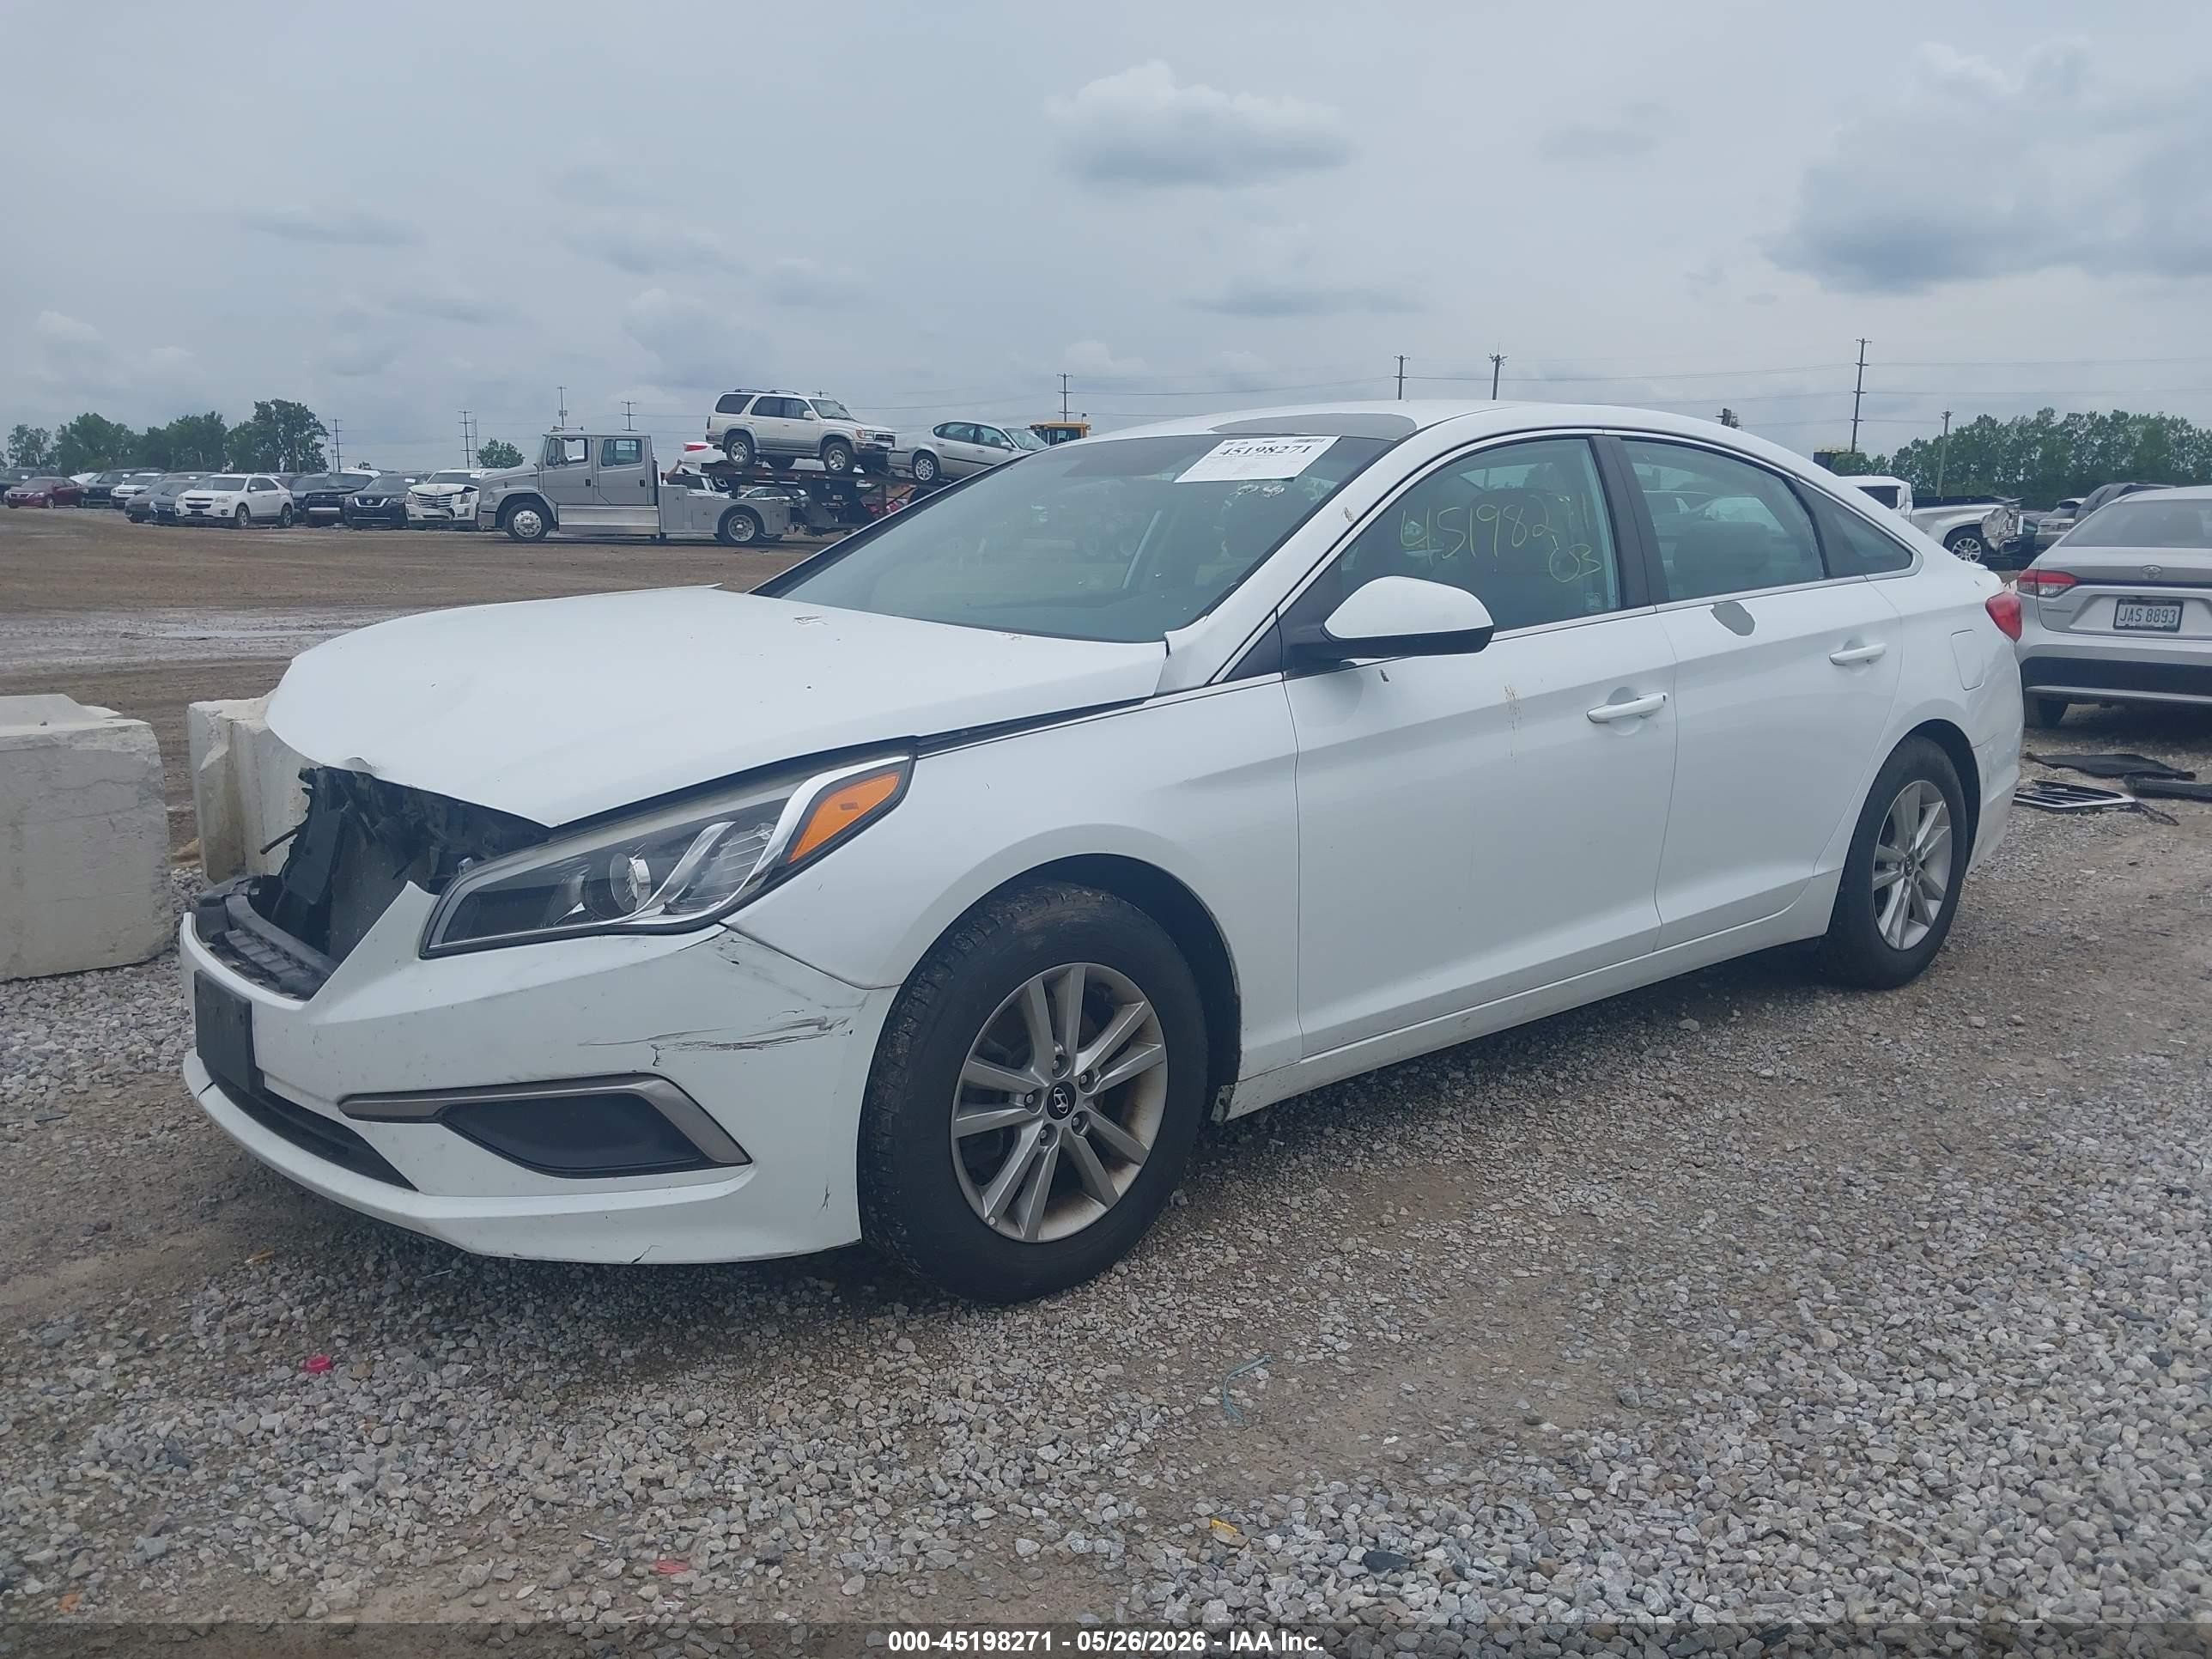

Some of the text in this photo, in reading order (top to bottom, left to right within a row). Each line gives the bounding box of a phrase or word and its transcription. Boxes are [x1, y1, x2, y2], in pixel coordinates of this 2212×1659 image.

[1219, 445, 1313, 457] 45198271
[2119, 608, 2176, 623] JAS 8893
